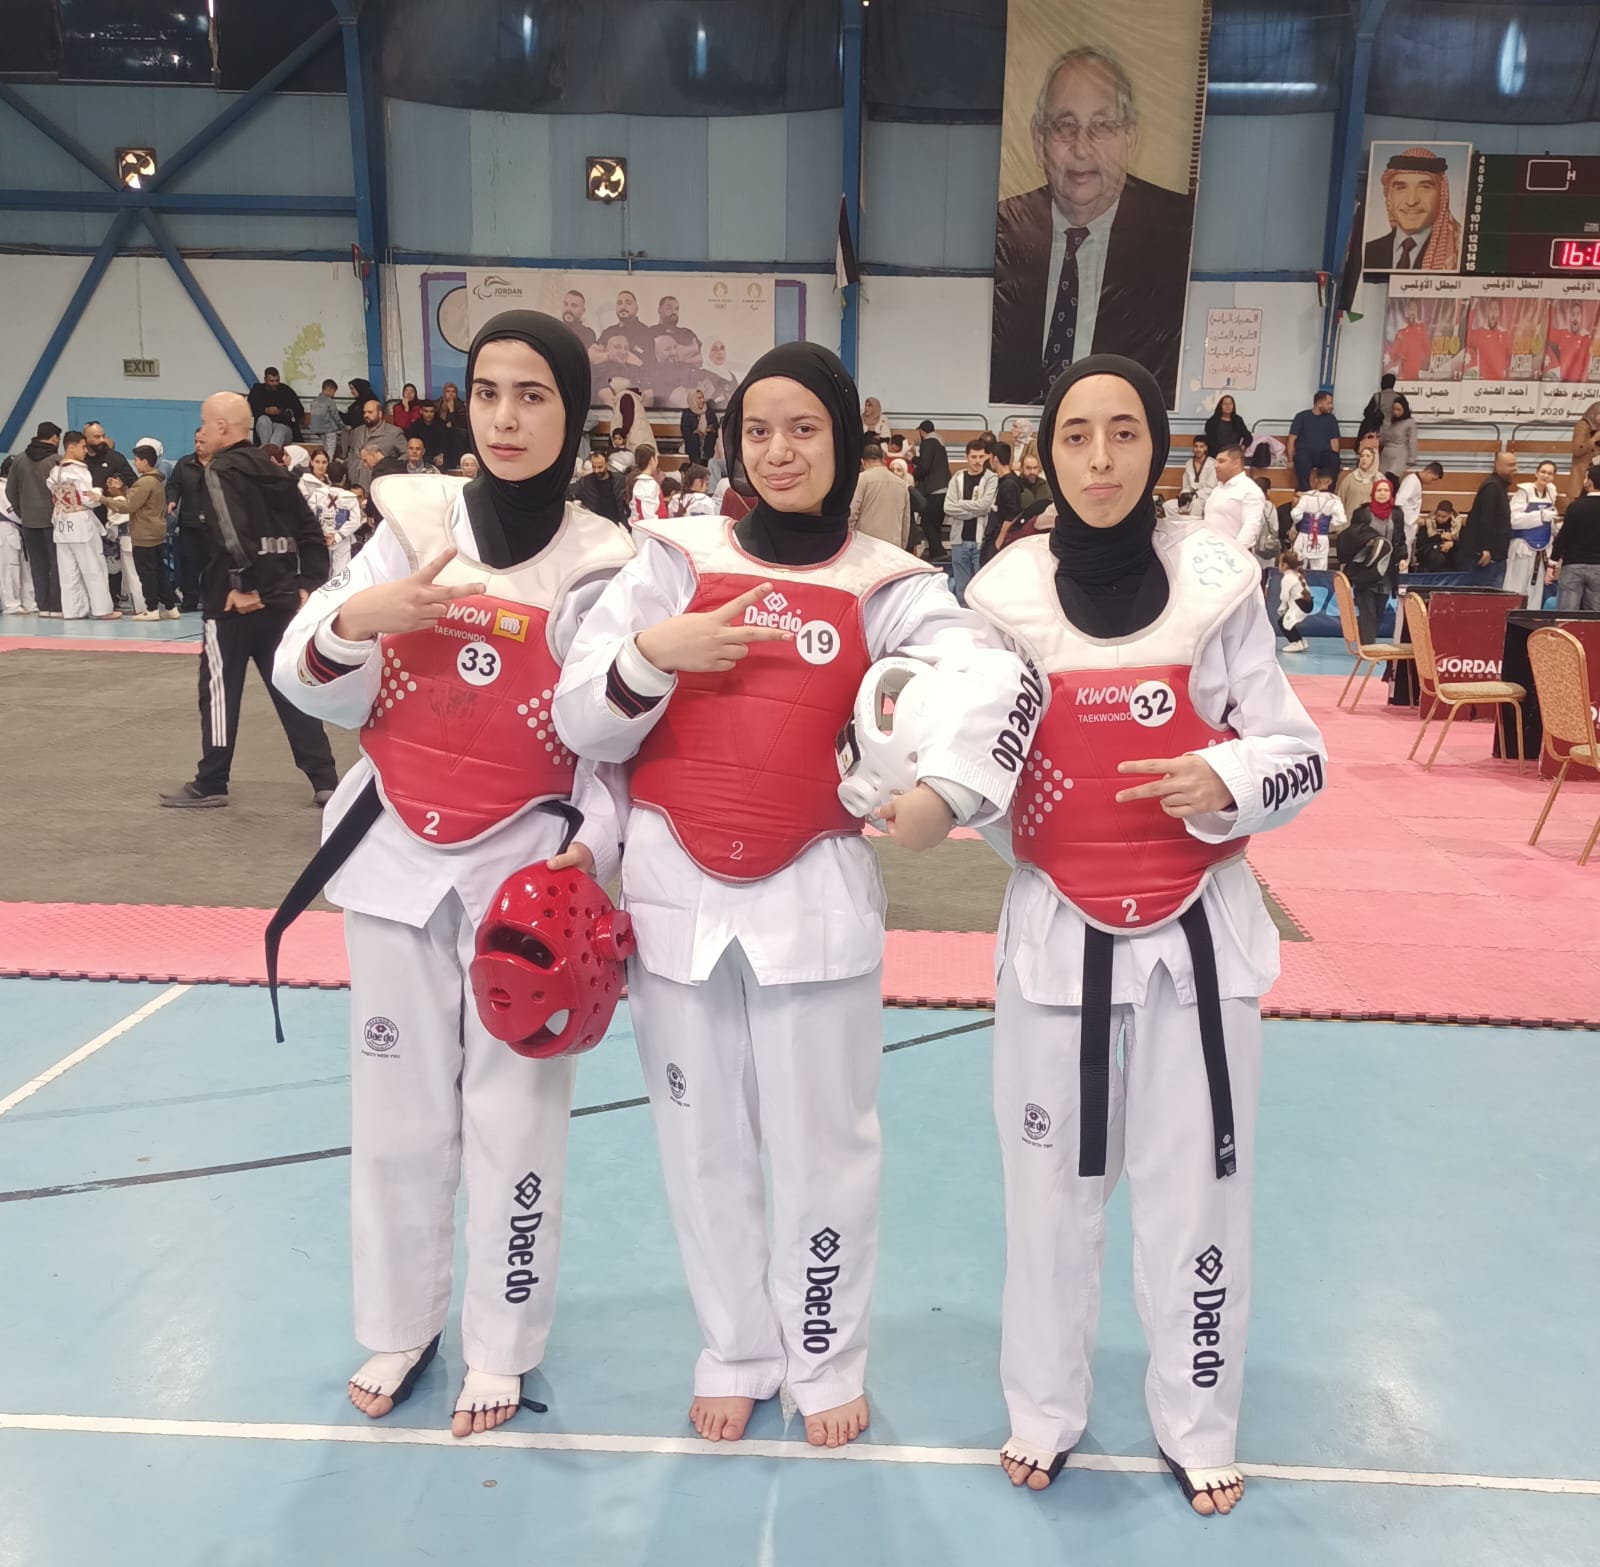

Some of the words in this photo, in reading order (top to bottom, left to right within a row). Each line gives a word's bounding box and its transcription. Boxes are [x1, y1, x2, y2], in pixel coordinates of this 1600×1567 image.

[1479, 155, 1486, 164] 4
[1478, 165, 1485, 174] 5
[1567, 170, 1577, 181] H
[1477, 174, 1484, 183] 6
[1477, 184, 1484, 193] 7
[1475, 195, 1482, 204] 8
[1474, 204, 1481, 213] 9
[1470, 214, 1480, 223] 10
[1469, 223, 1479, 232] 11
[1468, 234, 1479, 243] 12
[1467, 243, 1478, 252] 13
[1466, 253, 1477, 262] 14
[1465, 262, 1476, 271] 15
[494, 287, 523, 295] JORDAN
[123, 359, 155, 373] EXIT
[1462, 405, 1487, 415] 2020
[1540, 407, 1564, 416] 2020
[444, 603, 491, 627] WON
[743, 605, 802, 633] Daedo
[434, 625, 487, 644] TAEKWONDO
[800, 629, 834, 655] 19
[461, 647, 497, 677] 33
[1075, 685, 1133, 706] KWON
[1133, 688, 1173, 721] 32
[991, 672, 1042, 773] Daedo
[1077, 711, 1134, 723] TAEKWONDO
[1262, 754, 1324, 812] Daedo
[422, 810, 441, 836] 2
[730, 840, 744, 861] 2
[1121, 898, 1141, 923] 2
[504, 1211, 544, 1304] Daedo
[802, 1264, 841, 1354] Daedo
[1191, 1287, 1227, 1389] Daedo
